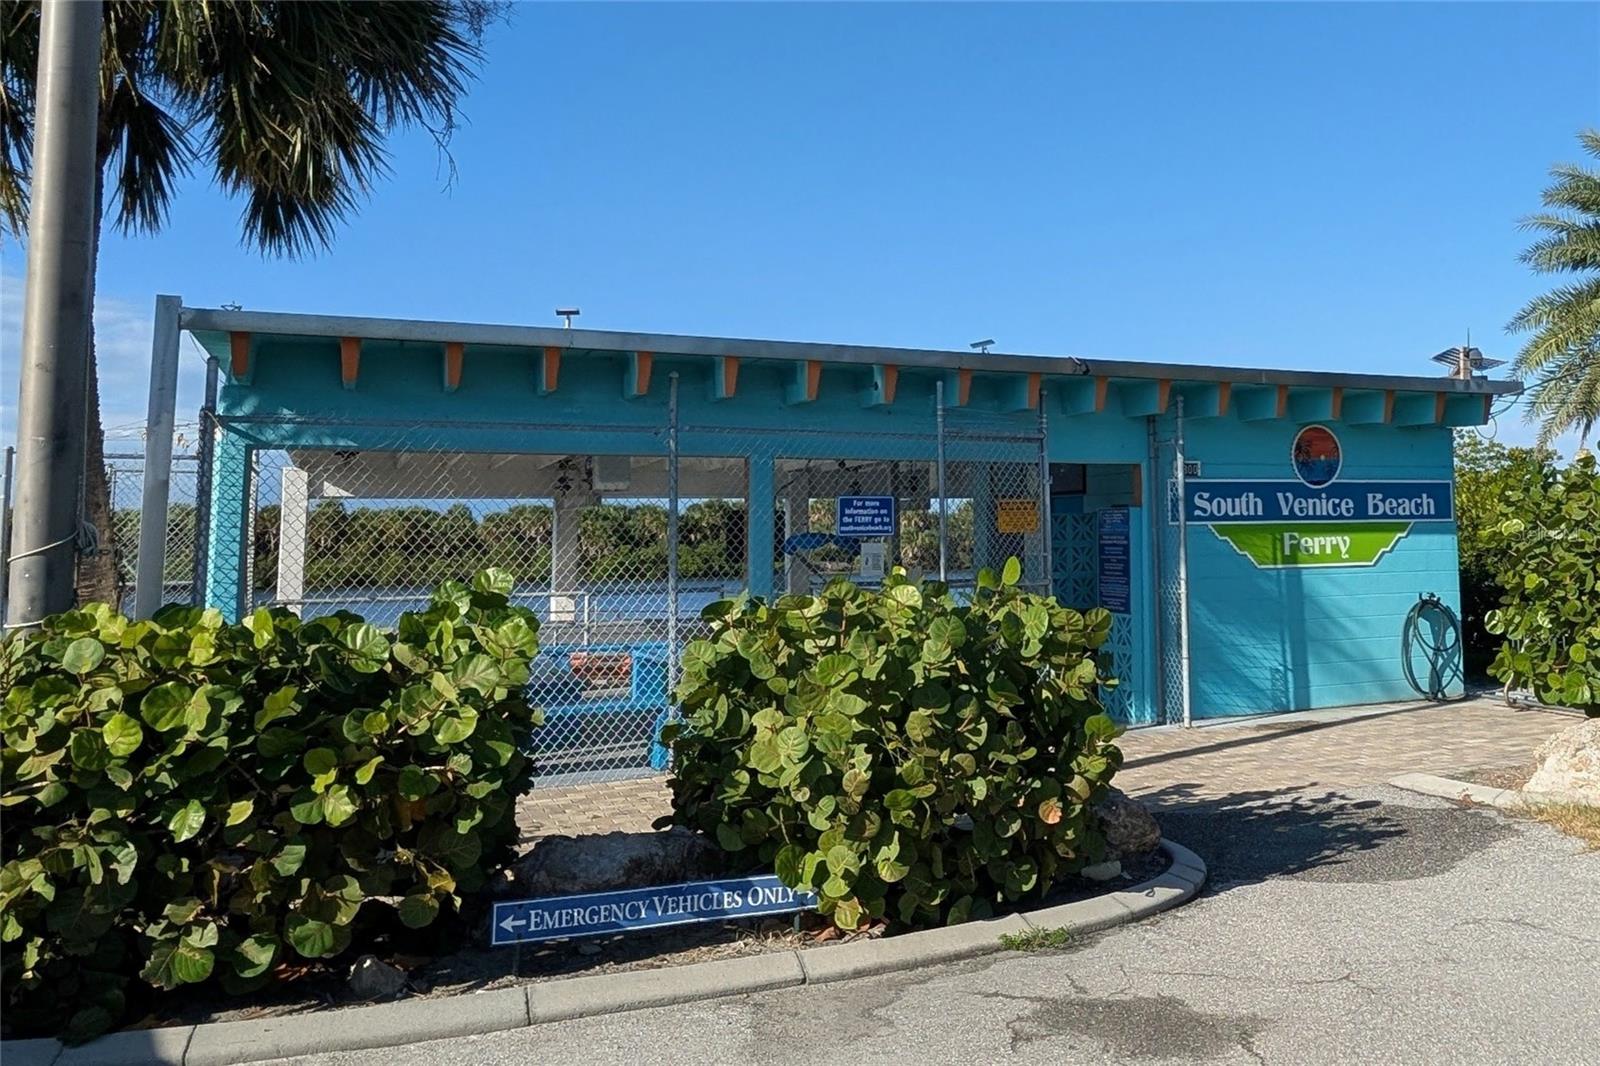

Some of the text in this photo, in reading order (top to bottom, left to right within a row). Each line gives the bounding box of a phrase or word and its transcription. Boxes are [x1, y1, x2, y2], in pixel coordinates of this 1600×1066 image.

[853, 499, 864, 507] For
[1194, 491, 1435, 517] South Venice Beach
[1283, 532, 1351, 559] Ferry
[528, 885, 797, 933] EMERGENCY VEHICLES ONLY
